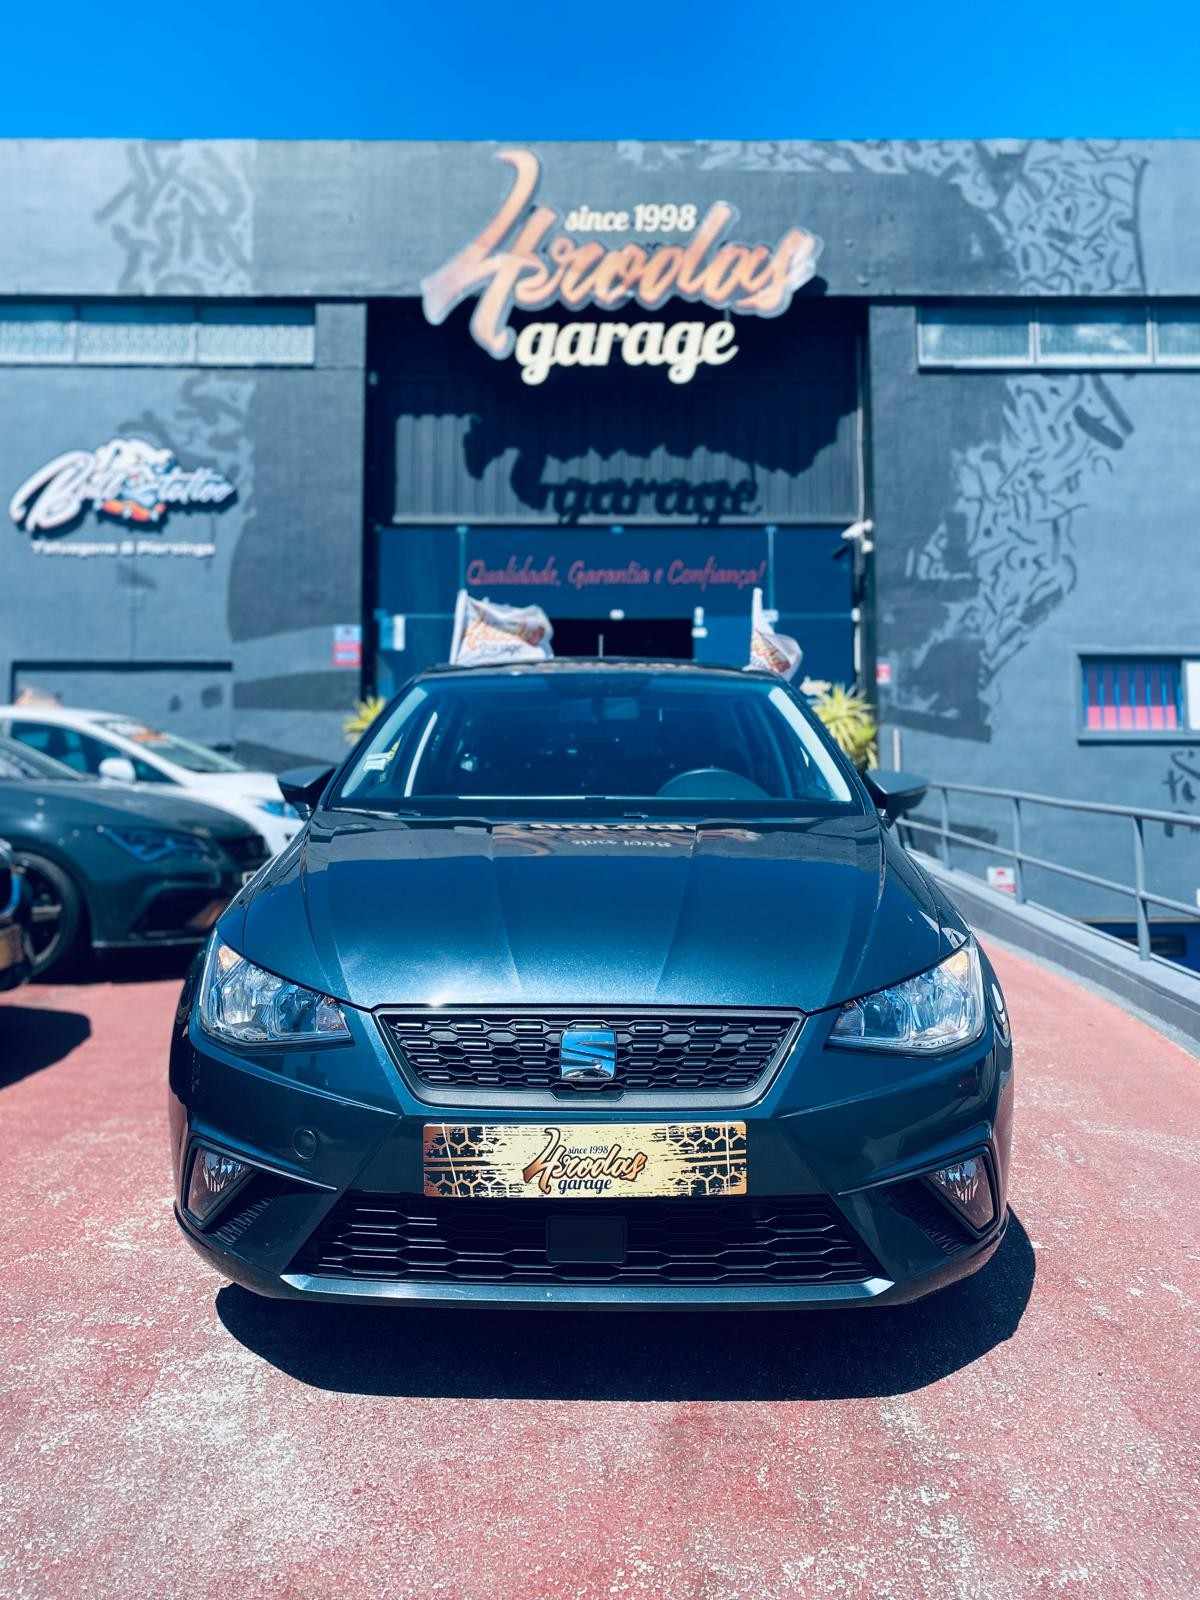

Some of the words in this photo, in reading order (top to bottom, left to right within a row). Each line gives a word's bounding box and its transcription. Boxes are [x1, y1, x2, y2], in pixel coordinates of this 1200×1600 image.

[565, 206, 629, 232] since
[634, 204, 698, 232] 1998
[515, 320, 740, 385] garage
[567, 1146, 588, 1155] since
[589, 1145, 609, 1154] 1998
[558, 1178, 612, 1194] garage
